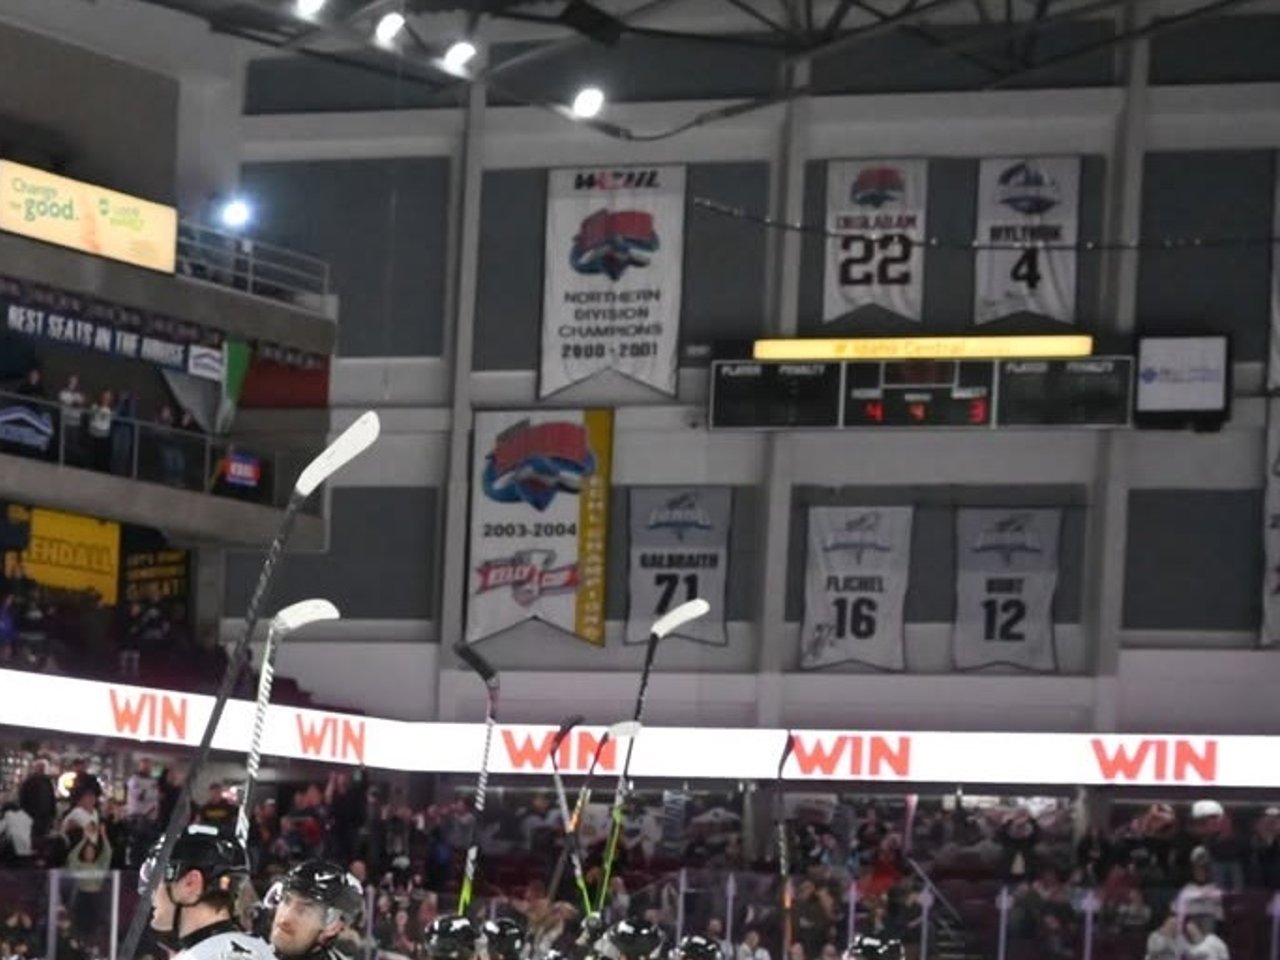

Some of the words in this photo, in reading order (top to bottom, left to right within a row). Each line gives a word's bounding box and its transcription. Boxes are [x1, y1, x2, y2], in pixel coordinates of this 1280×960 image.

[840, 234, 912, 286] 22
[1009, 243, 1042, 290] 4
[47, 309, 92, 347] SEATS
[93, 325, 113, 352] IN
[115, 330, 139, 358] THE
[557, 324, 664, 339] CHAMPIONS
[573, 309, 649, 322] DIVISION
[482, 523, 577, 538] 2003-2004
[651, 573, 700, 617] 71
[832, 596, 878, 639] 16
[982, 598, 1027, 642] 12
[109, 689, 188, 740] WIN
[297, 715, 366, 762] WIN
[500, 729, 617, 772] WIN
[790, 735, 912, 778] WIN
[1091, 739, 1218, 782] WIN
